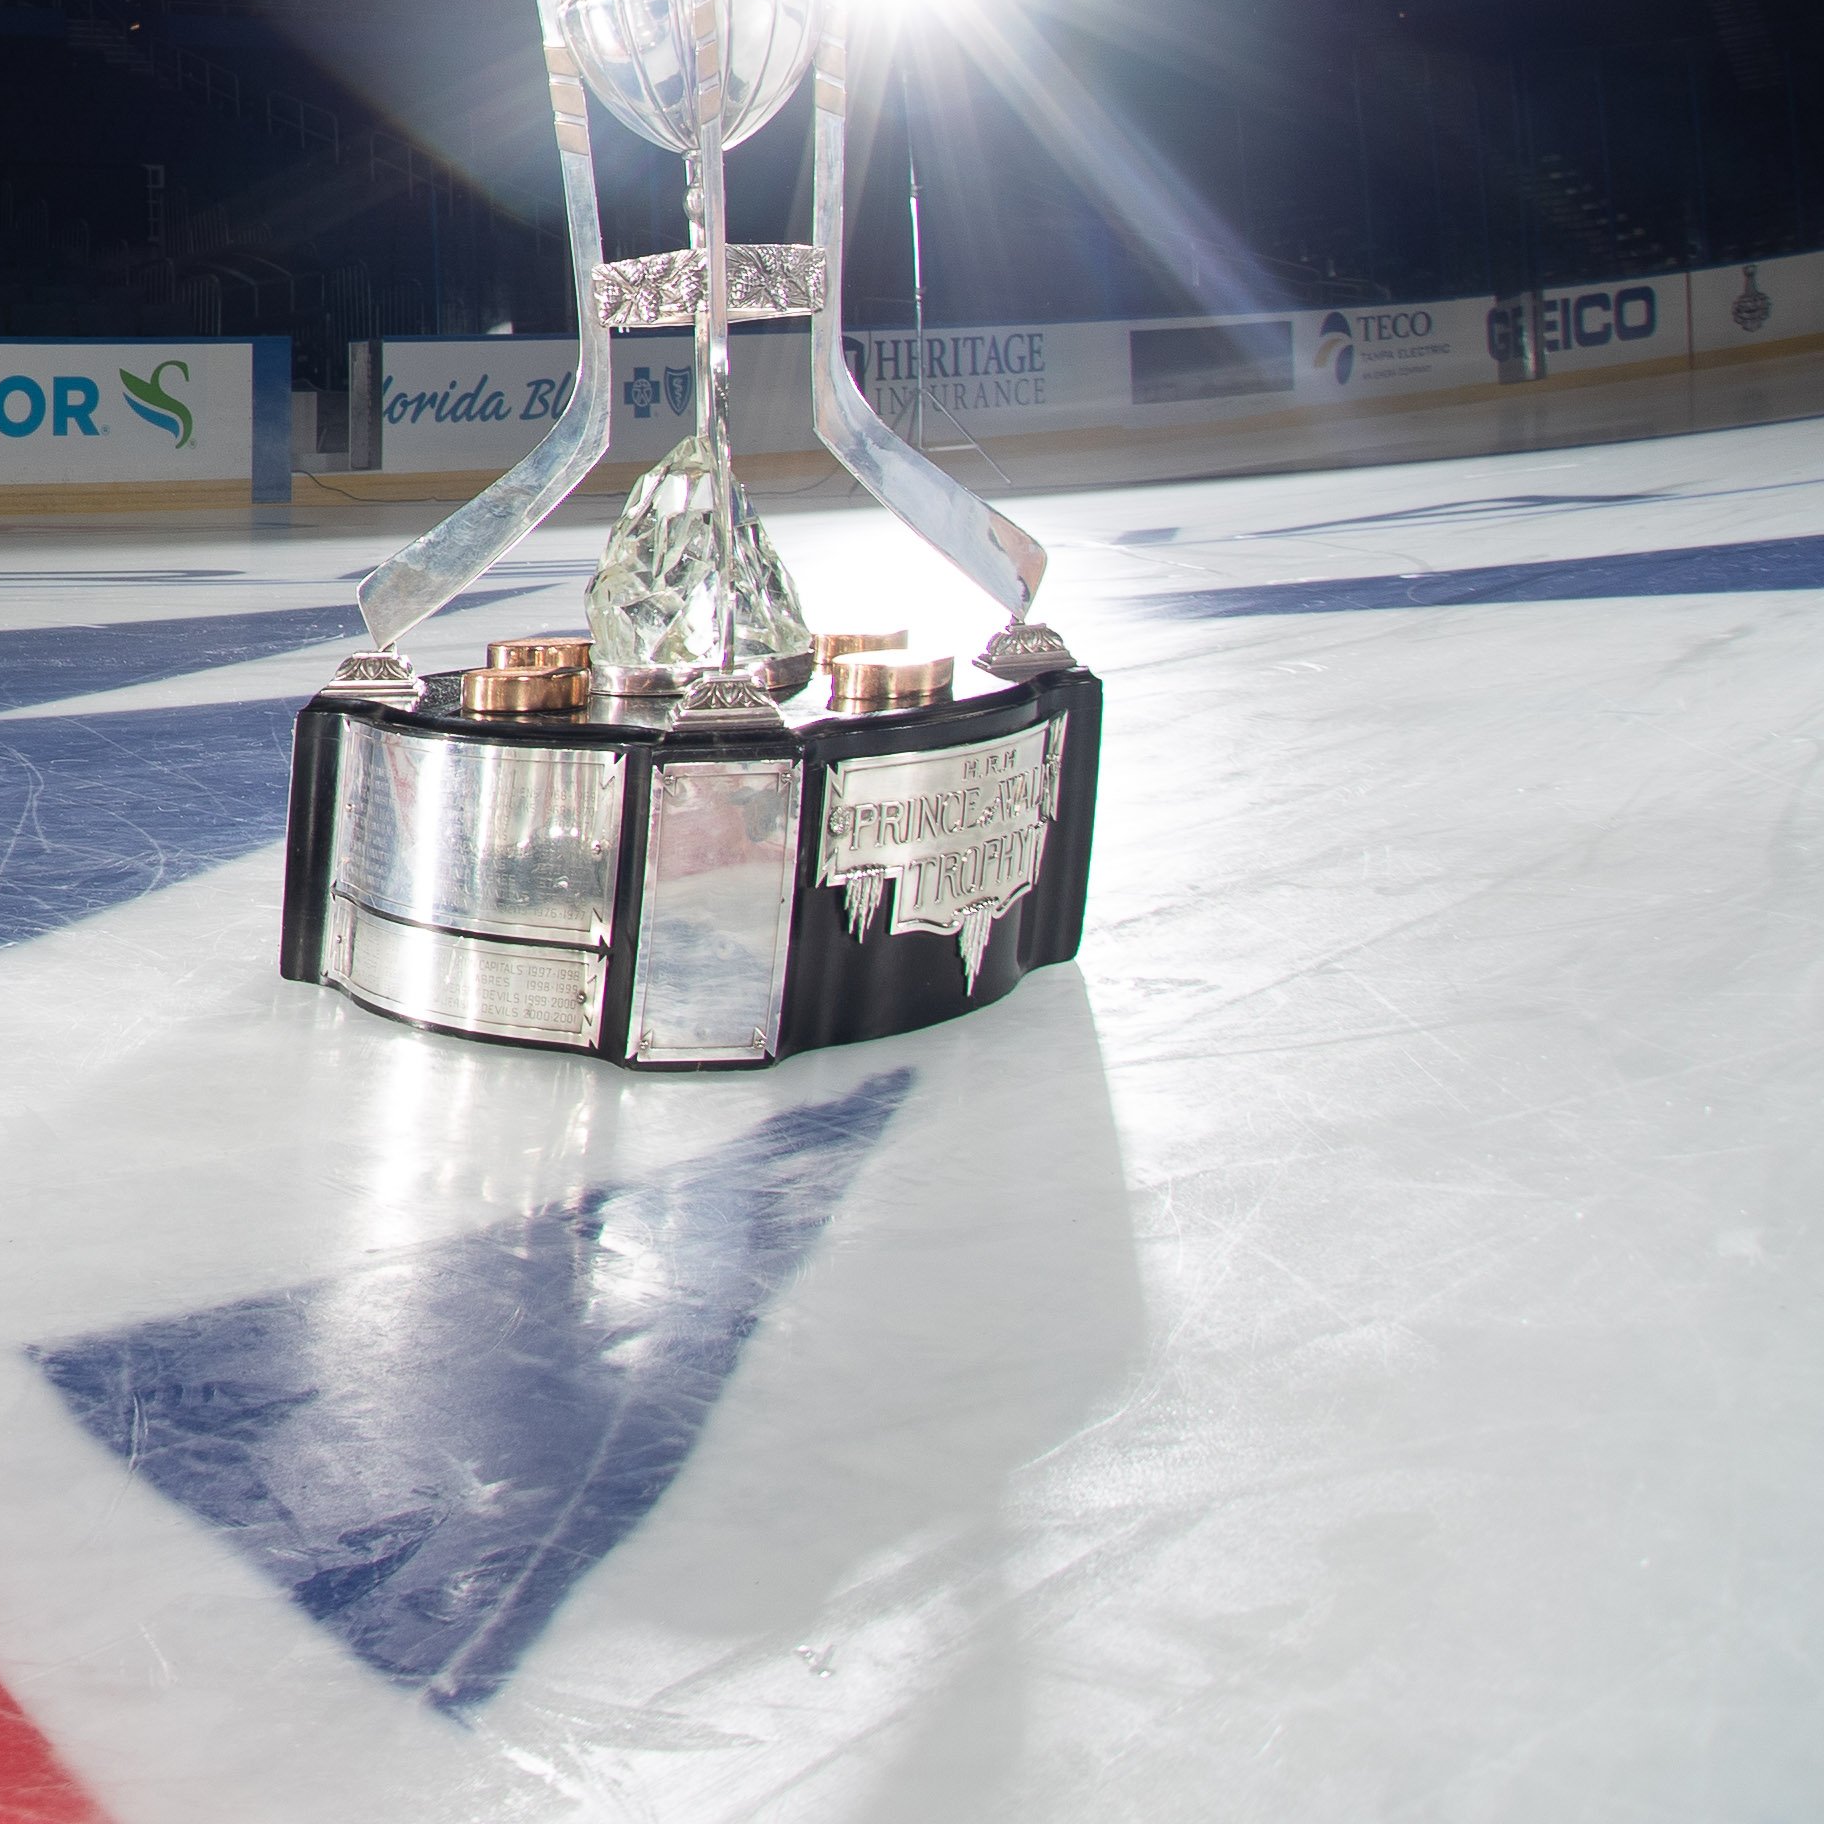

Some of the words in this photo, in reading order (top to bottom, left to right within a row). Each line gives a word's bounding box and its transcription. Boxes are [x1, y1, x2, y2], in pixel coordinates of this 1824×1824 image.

[1356, 311, 1432, 343] TECO
[1486, 285, 1657, 363] GEICO
[874, 333, 1046, 382] HERITAGE
[519, 370, 573, 421] Bl
[849, 786, 983, 852] PRINCE
[908, 824, 1036, 910] TROPHY
[475, 975, 511, 988] ABRES
[478, 959, 524, 977] CAPITALS
[480, 1003, 520, 1019] DEVILS
[481, 988, 521, 1005] DEVILS
